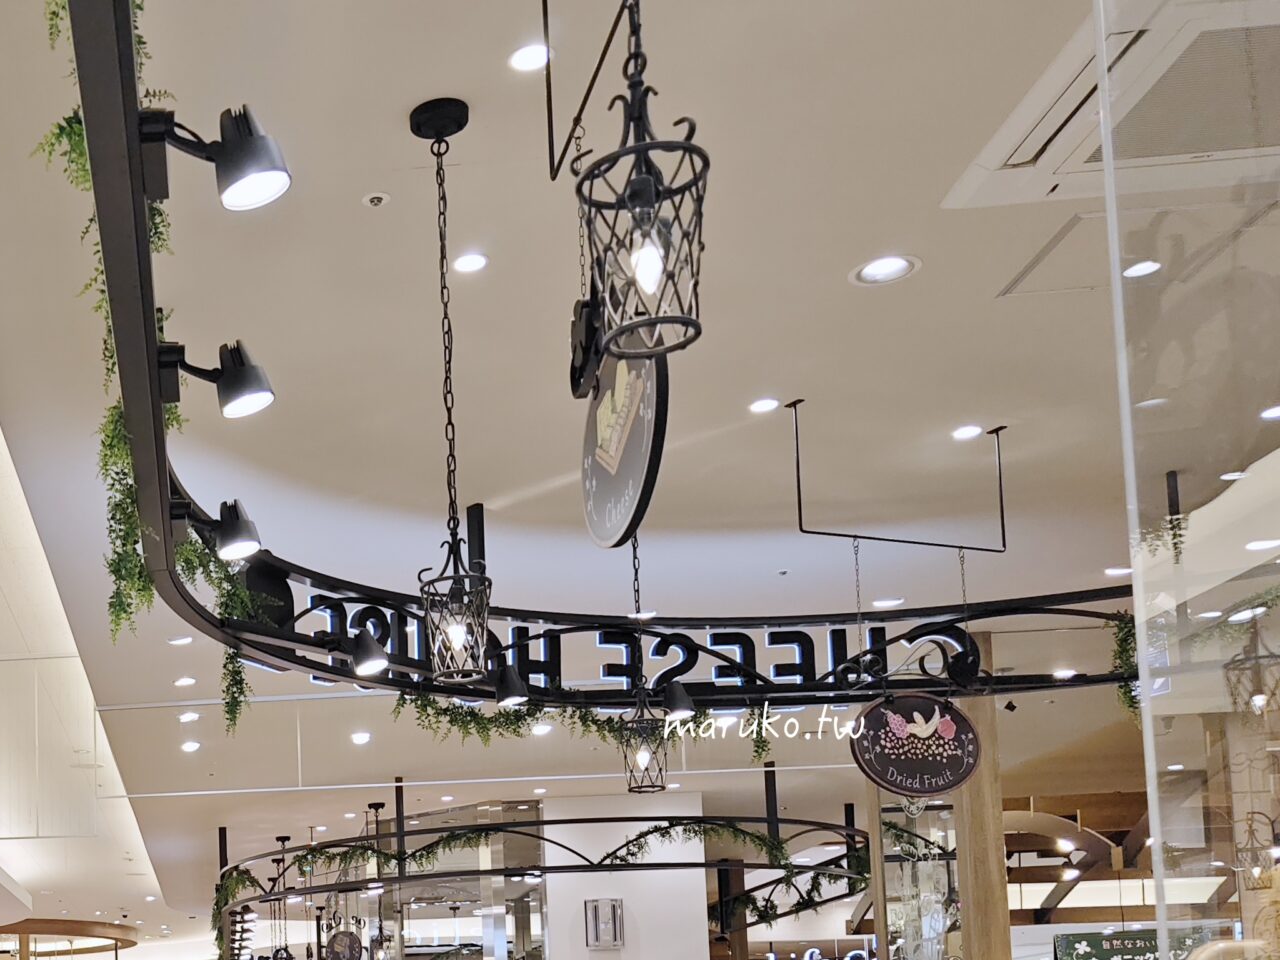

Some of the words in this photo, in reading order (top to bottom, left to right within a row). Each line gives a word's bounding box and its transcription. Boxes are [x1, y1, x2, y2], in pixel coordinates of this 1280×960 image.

[605, 479, 635, 529] Cheese
[886, 766, 920, 788] Dried
[923, 768, 954, 788] Fruit
